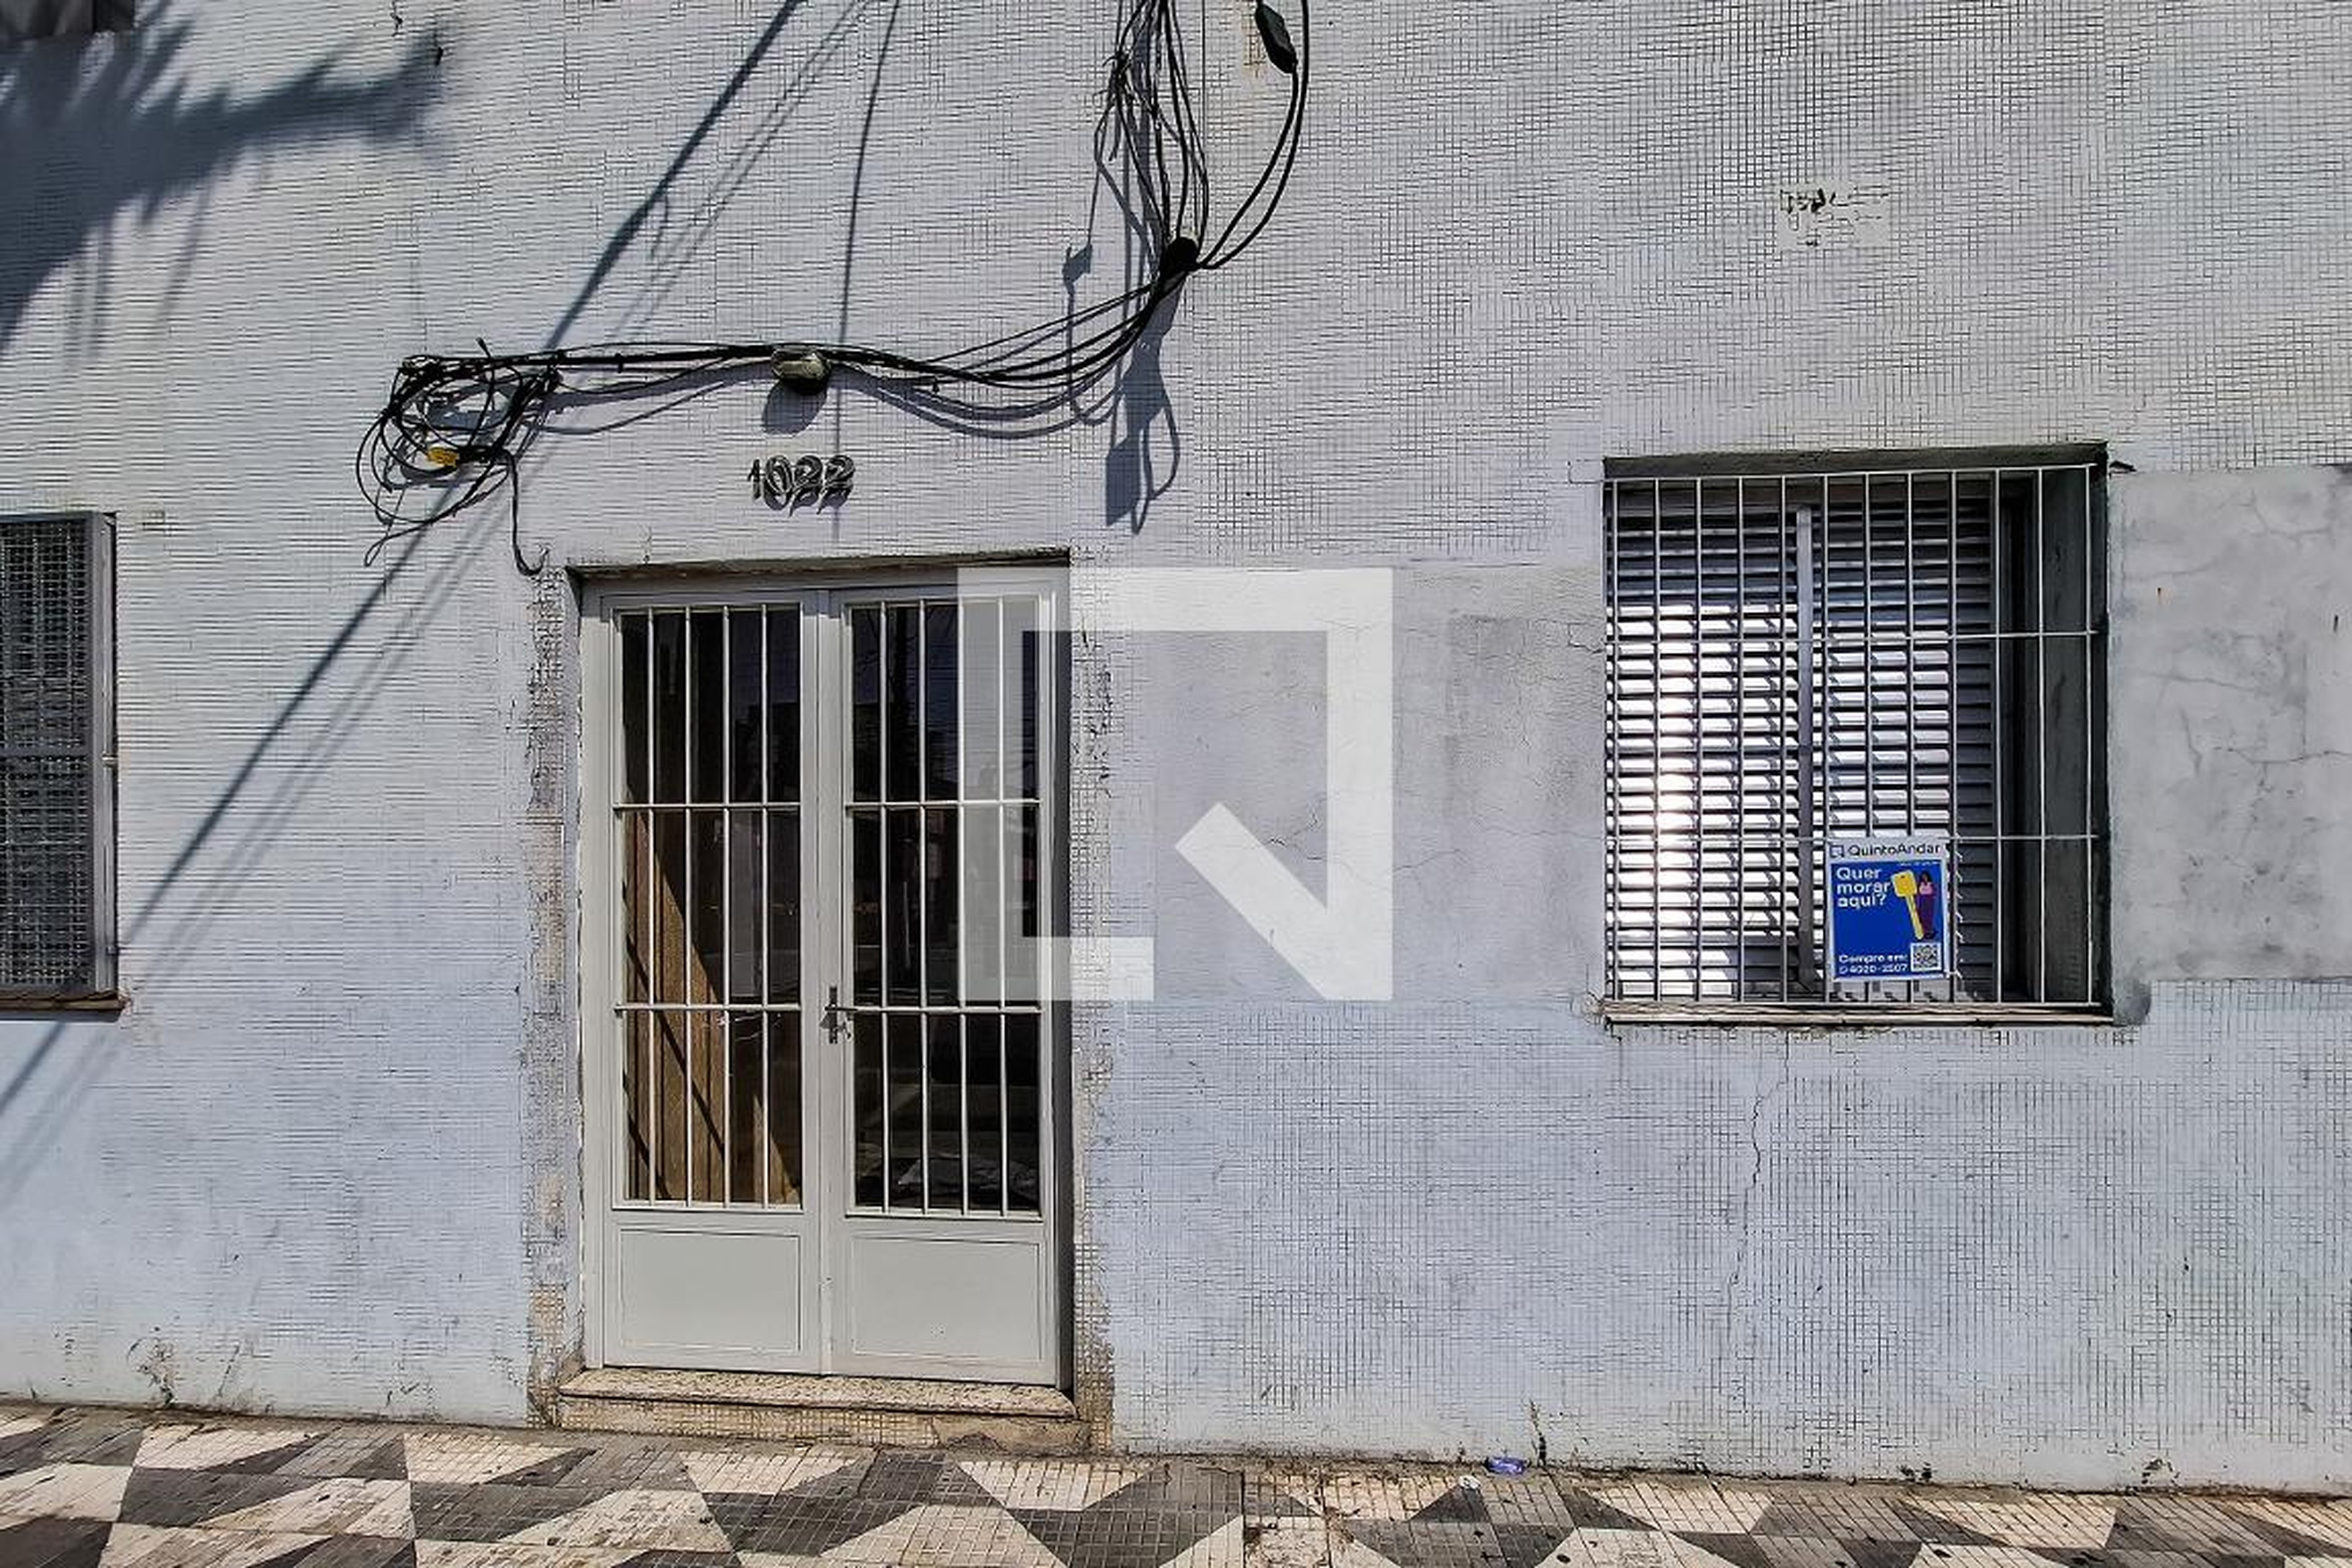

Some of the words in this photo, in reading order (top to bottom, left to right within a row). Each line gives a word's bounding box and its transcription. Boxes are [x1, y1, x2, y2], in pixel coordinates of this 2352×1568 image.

[747, 454, 856, 500] 1022
[1848, 843, 1940, 856] QuintoAndar
[1836, 867, 1882, 881] Quer
[1836, 881, 1891, 895] morar
[1837, 892, 1887, 910] aqui?
